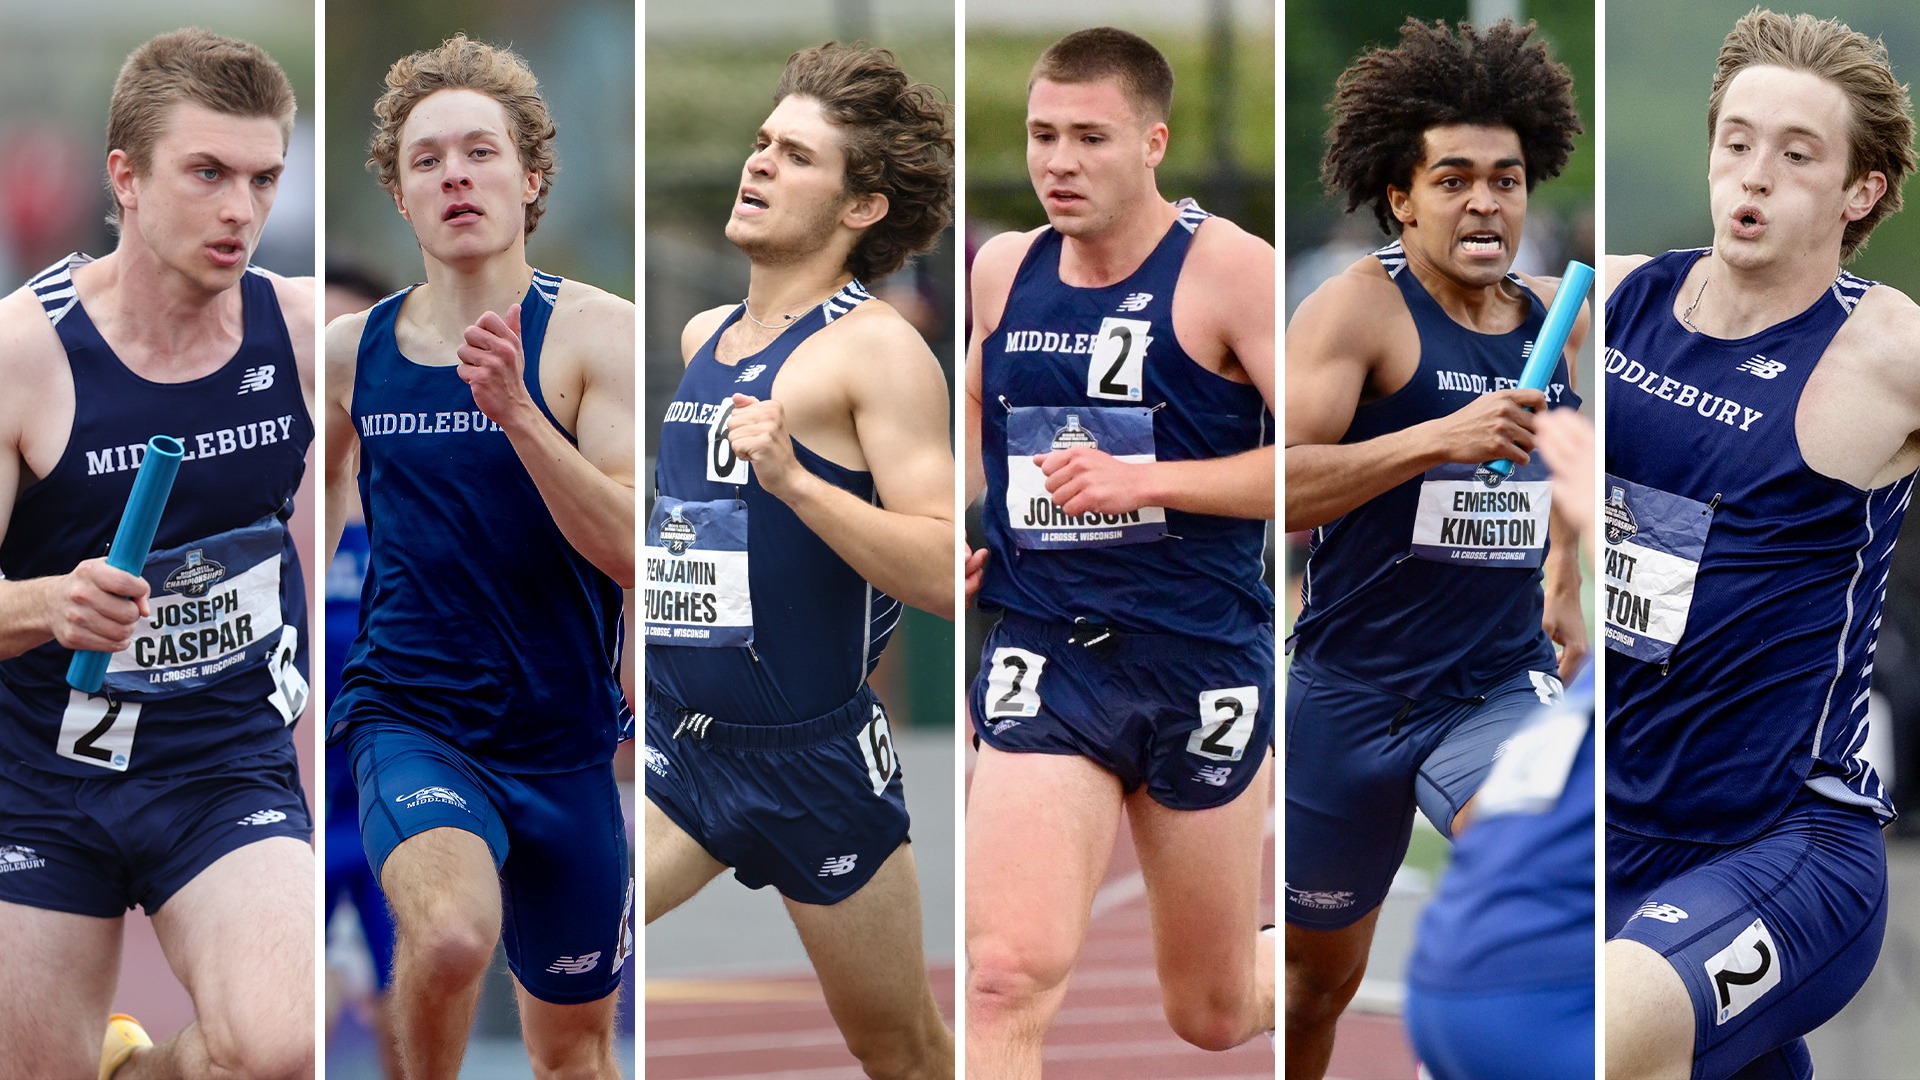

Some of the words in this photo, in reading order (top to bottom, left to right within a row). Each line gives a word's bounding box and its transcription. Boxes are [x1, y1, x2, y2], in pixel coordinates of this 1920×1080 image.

[1099, 326, 1133, 395] 2
[1605, 346, 1763, 432] IDDLEBURY
[361, 411, 505, 437] MIDDLEBU
[85, 415, 293, 475] MIDLEBURY
[1452, 491, 1530, 513] EMERSON
[1080, 531, 1122, 541] WISCONSIN
[1440, 517, 1535, 547] KINGTON
[1451, 551, 1459, 559] LA
[1460, 551, 1488, 560] CROSSE,
[1489, 552, 1526, 561] WISCONSIN
[1605, 547, 1637, 583] ATT
[166, 569, 223, 588] CHAMPIONSHIPS
[150, 589, 238, 629] JOSEPH
[645, 589, 717, 624] HUGHES
[1605, 584, 1651, 633] TON
[135, 613, 253, 668] CASPAR
[674, 628, 710, 639] WISCONSIN
[150, 673, 161, 684] LA
[162, 667, 199, 683] CROSSE,
[201, 651, 246, 677] WISCONSIN
[993, 655, 1028, 713] 2
[73, 693, 122, 763] 2
[1200, 696, 1243, 757] 2
[869, 714, 891, 782] 6
[1714, 939, 1771, 1009] 2
